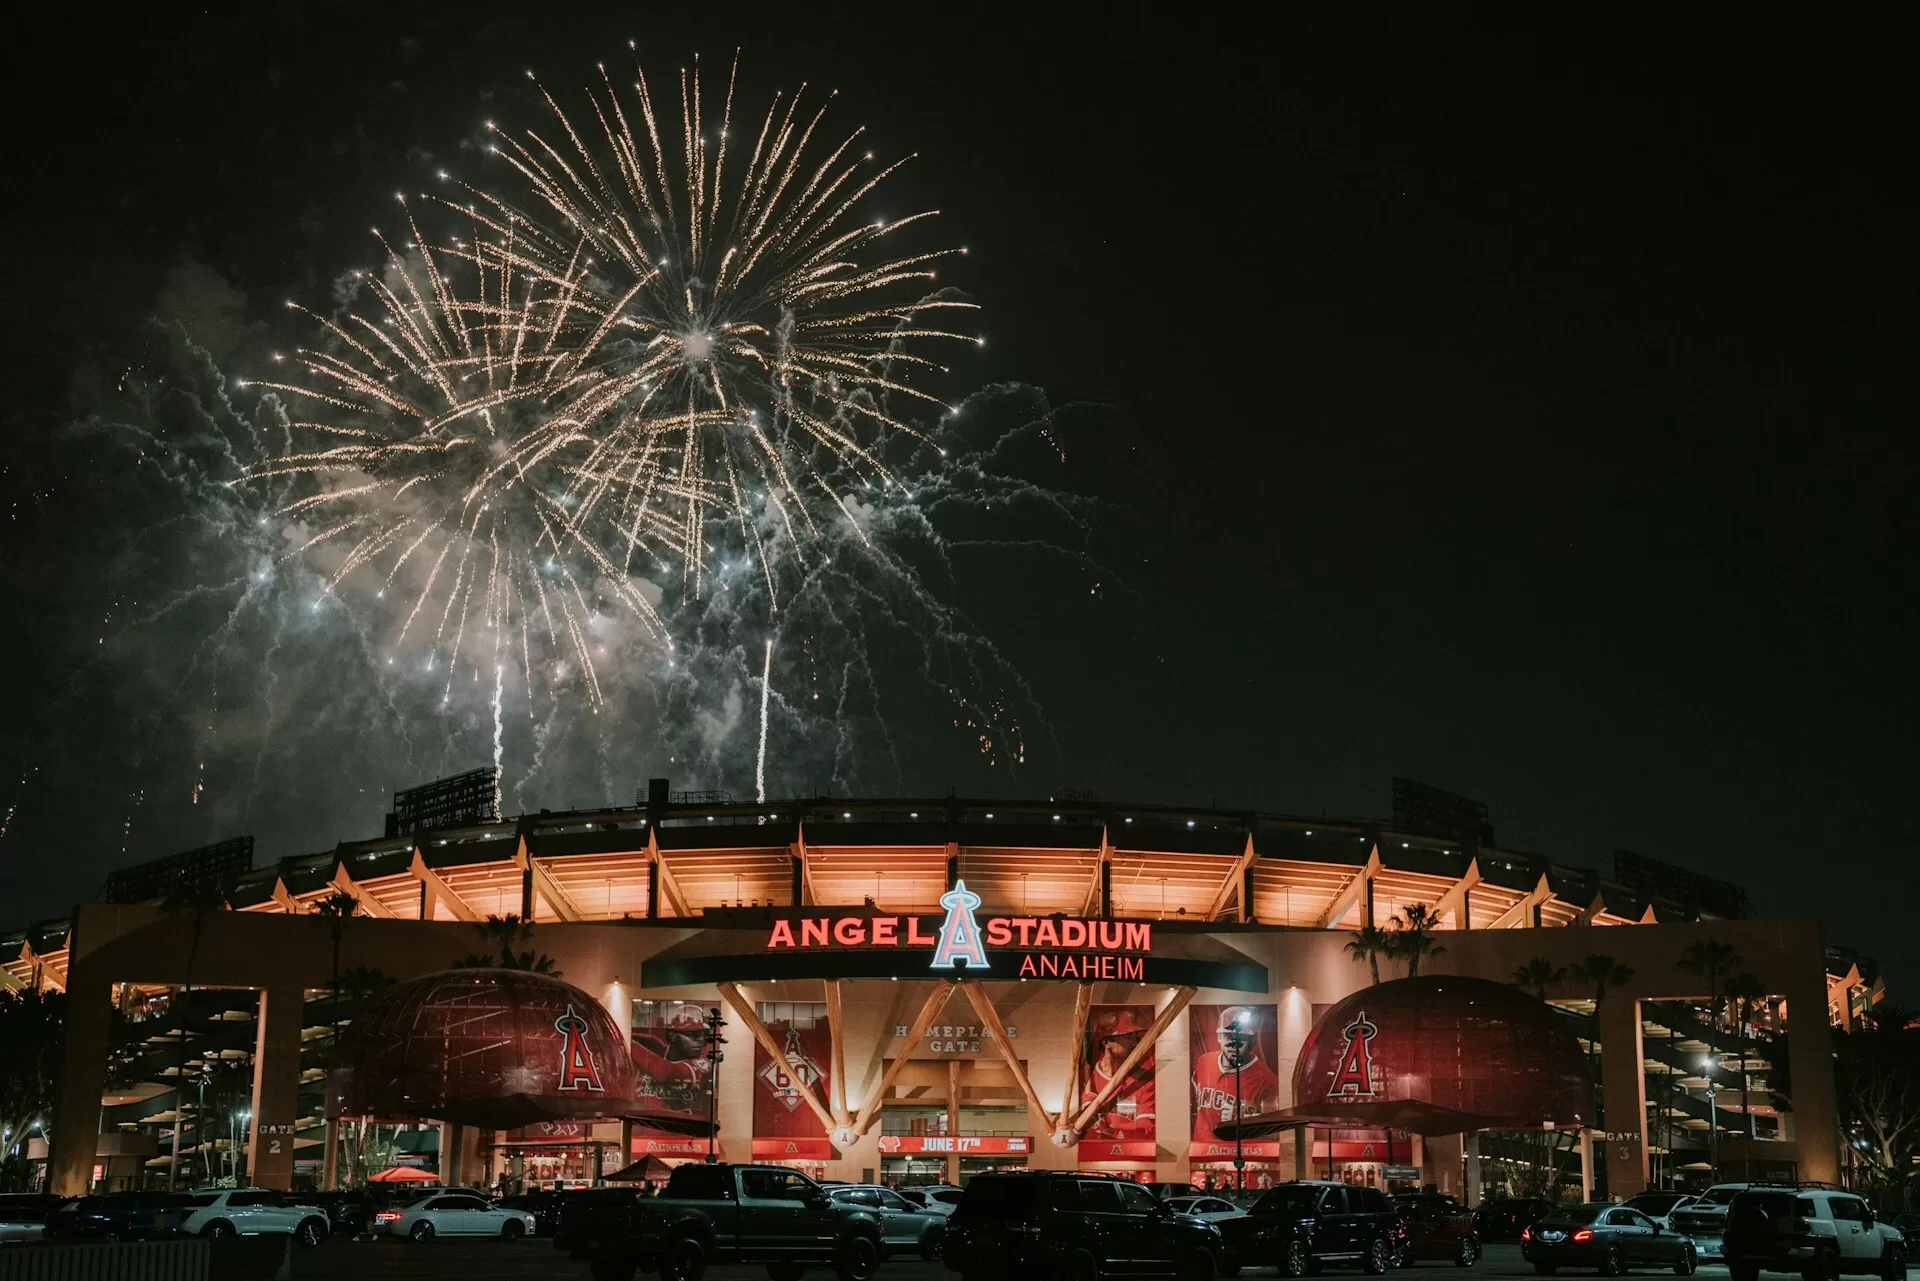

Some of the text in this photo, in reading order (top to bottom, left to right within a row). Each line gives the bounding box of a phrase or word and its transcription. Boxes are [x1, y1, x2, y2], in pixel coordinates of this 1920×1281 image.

[767, 917, 935, 948] ANGEL
[986, 917, 1151, 951] STADIUM
[1019, 954, 1143, 980] ANAHEIM
[894, 1026, 1017, 1038] HMEPLAE
[930, 1041, 981, 1052] GATE
[776, 1064, 808, 1088] 60
[260, 1125, 295, 1134] GATE
[1606, 1132, 1640, 1141] GATE
[269, 1140, 280, 1154] 2
[920, 1137, 980, 1151] JUNE 17TH
[1619, 1146, 1630, 1160] 3
